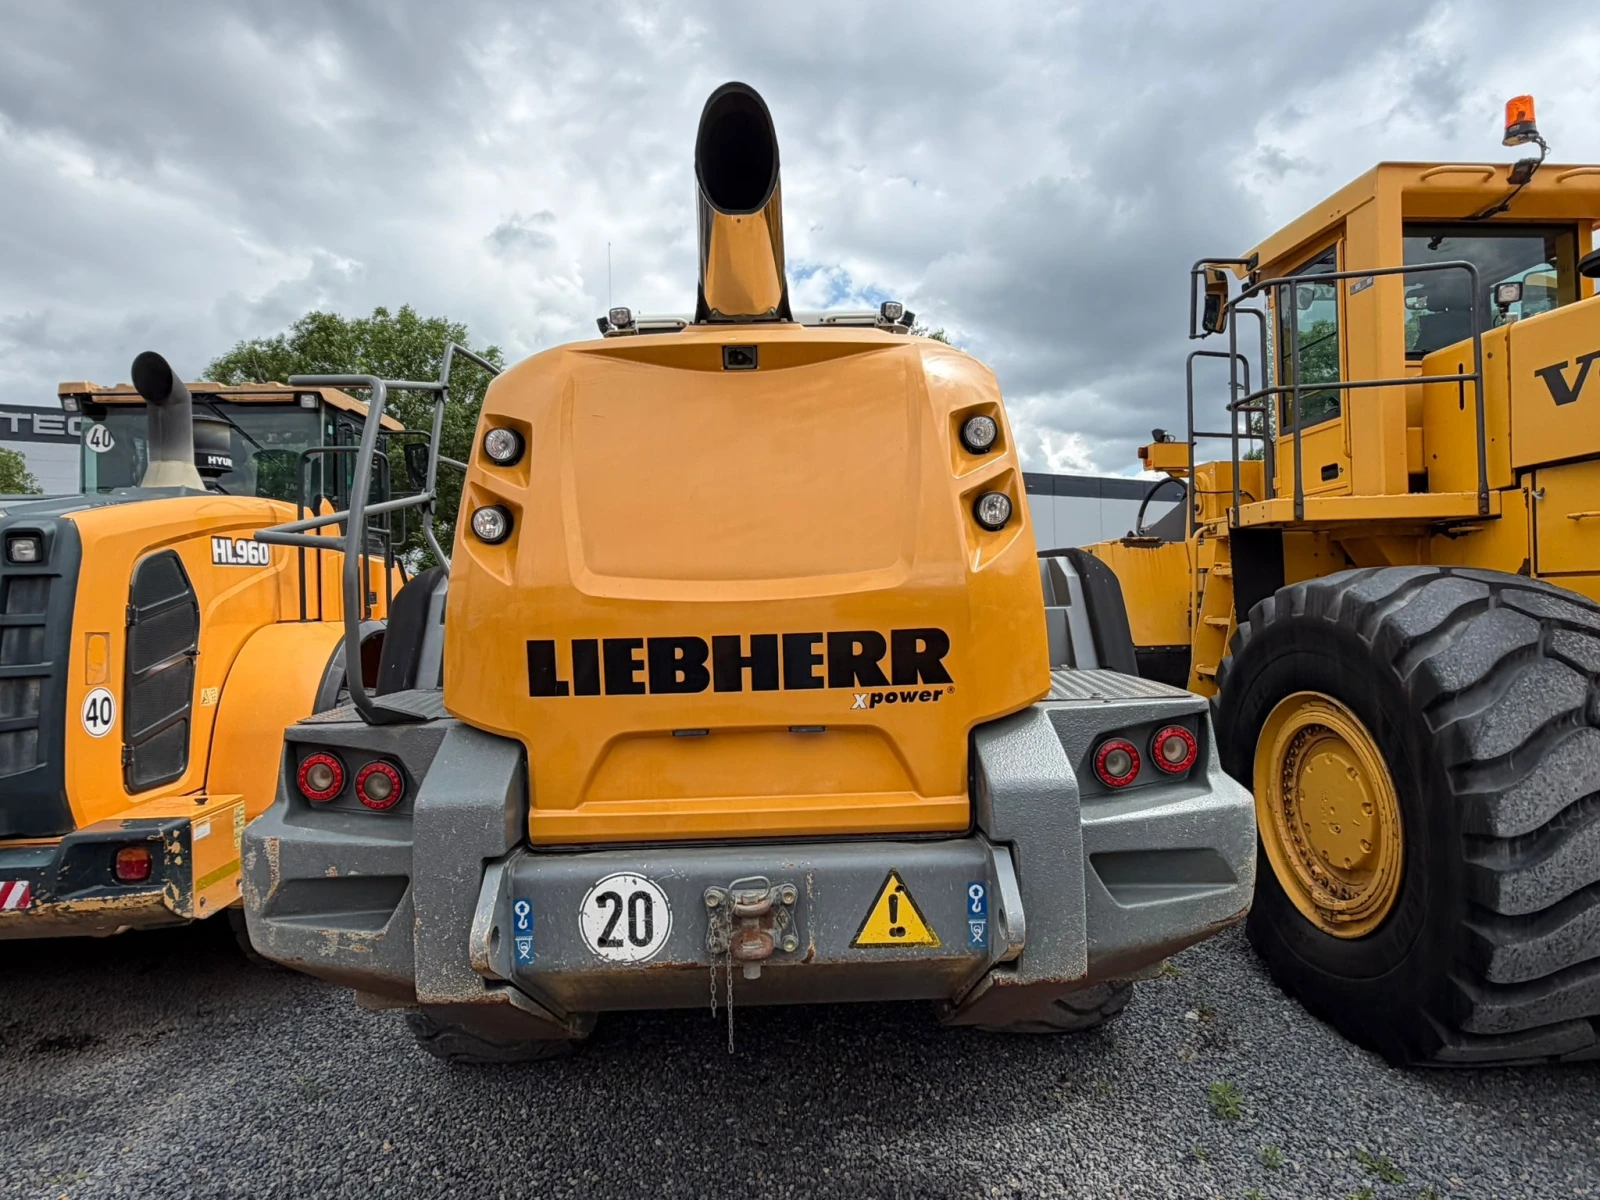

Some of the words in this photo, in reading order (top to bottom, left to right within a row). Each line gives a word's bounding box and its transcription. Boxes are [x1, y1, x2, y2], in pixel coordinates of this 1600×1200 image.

[90, 428, 111, 448] 40
[211, 537, 269, 565] HL960
[526, 627, 954, 697] LIEBHERR
[86, 696, 112, 727] 40
[595, 890, 654, 948] 20
